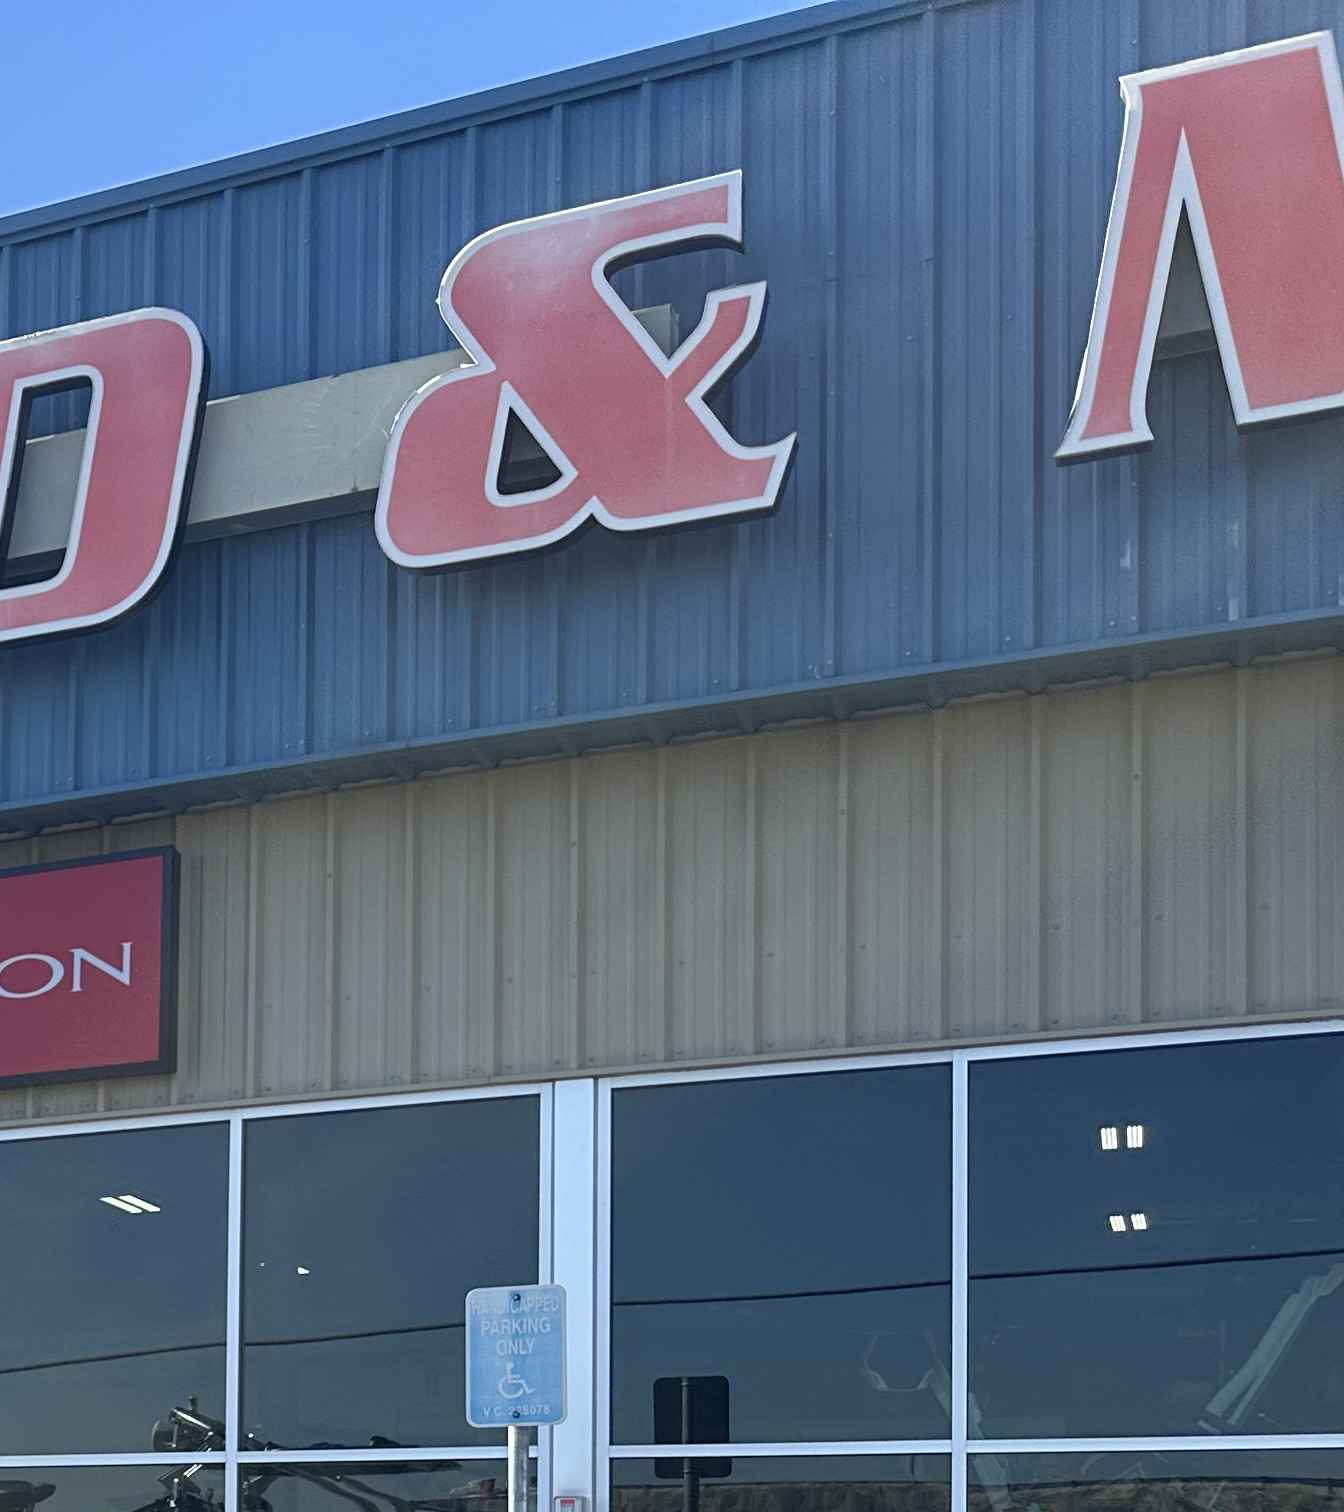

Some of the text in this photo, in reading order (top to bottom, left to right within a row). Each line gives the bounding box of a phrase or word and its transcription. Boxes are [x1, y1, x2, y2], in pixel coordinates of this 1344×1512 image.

[375, 169, 797, 568] &
[480, 1316, 552, 1336] PARKING
[496, 1337, 535, 1356] ONLY
